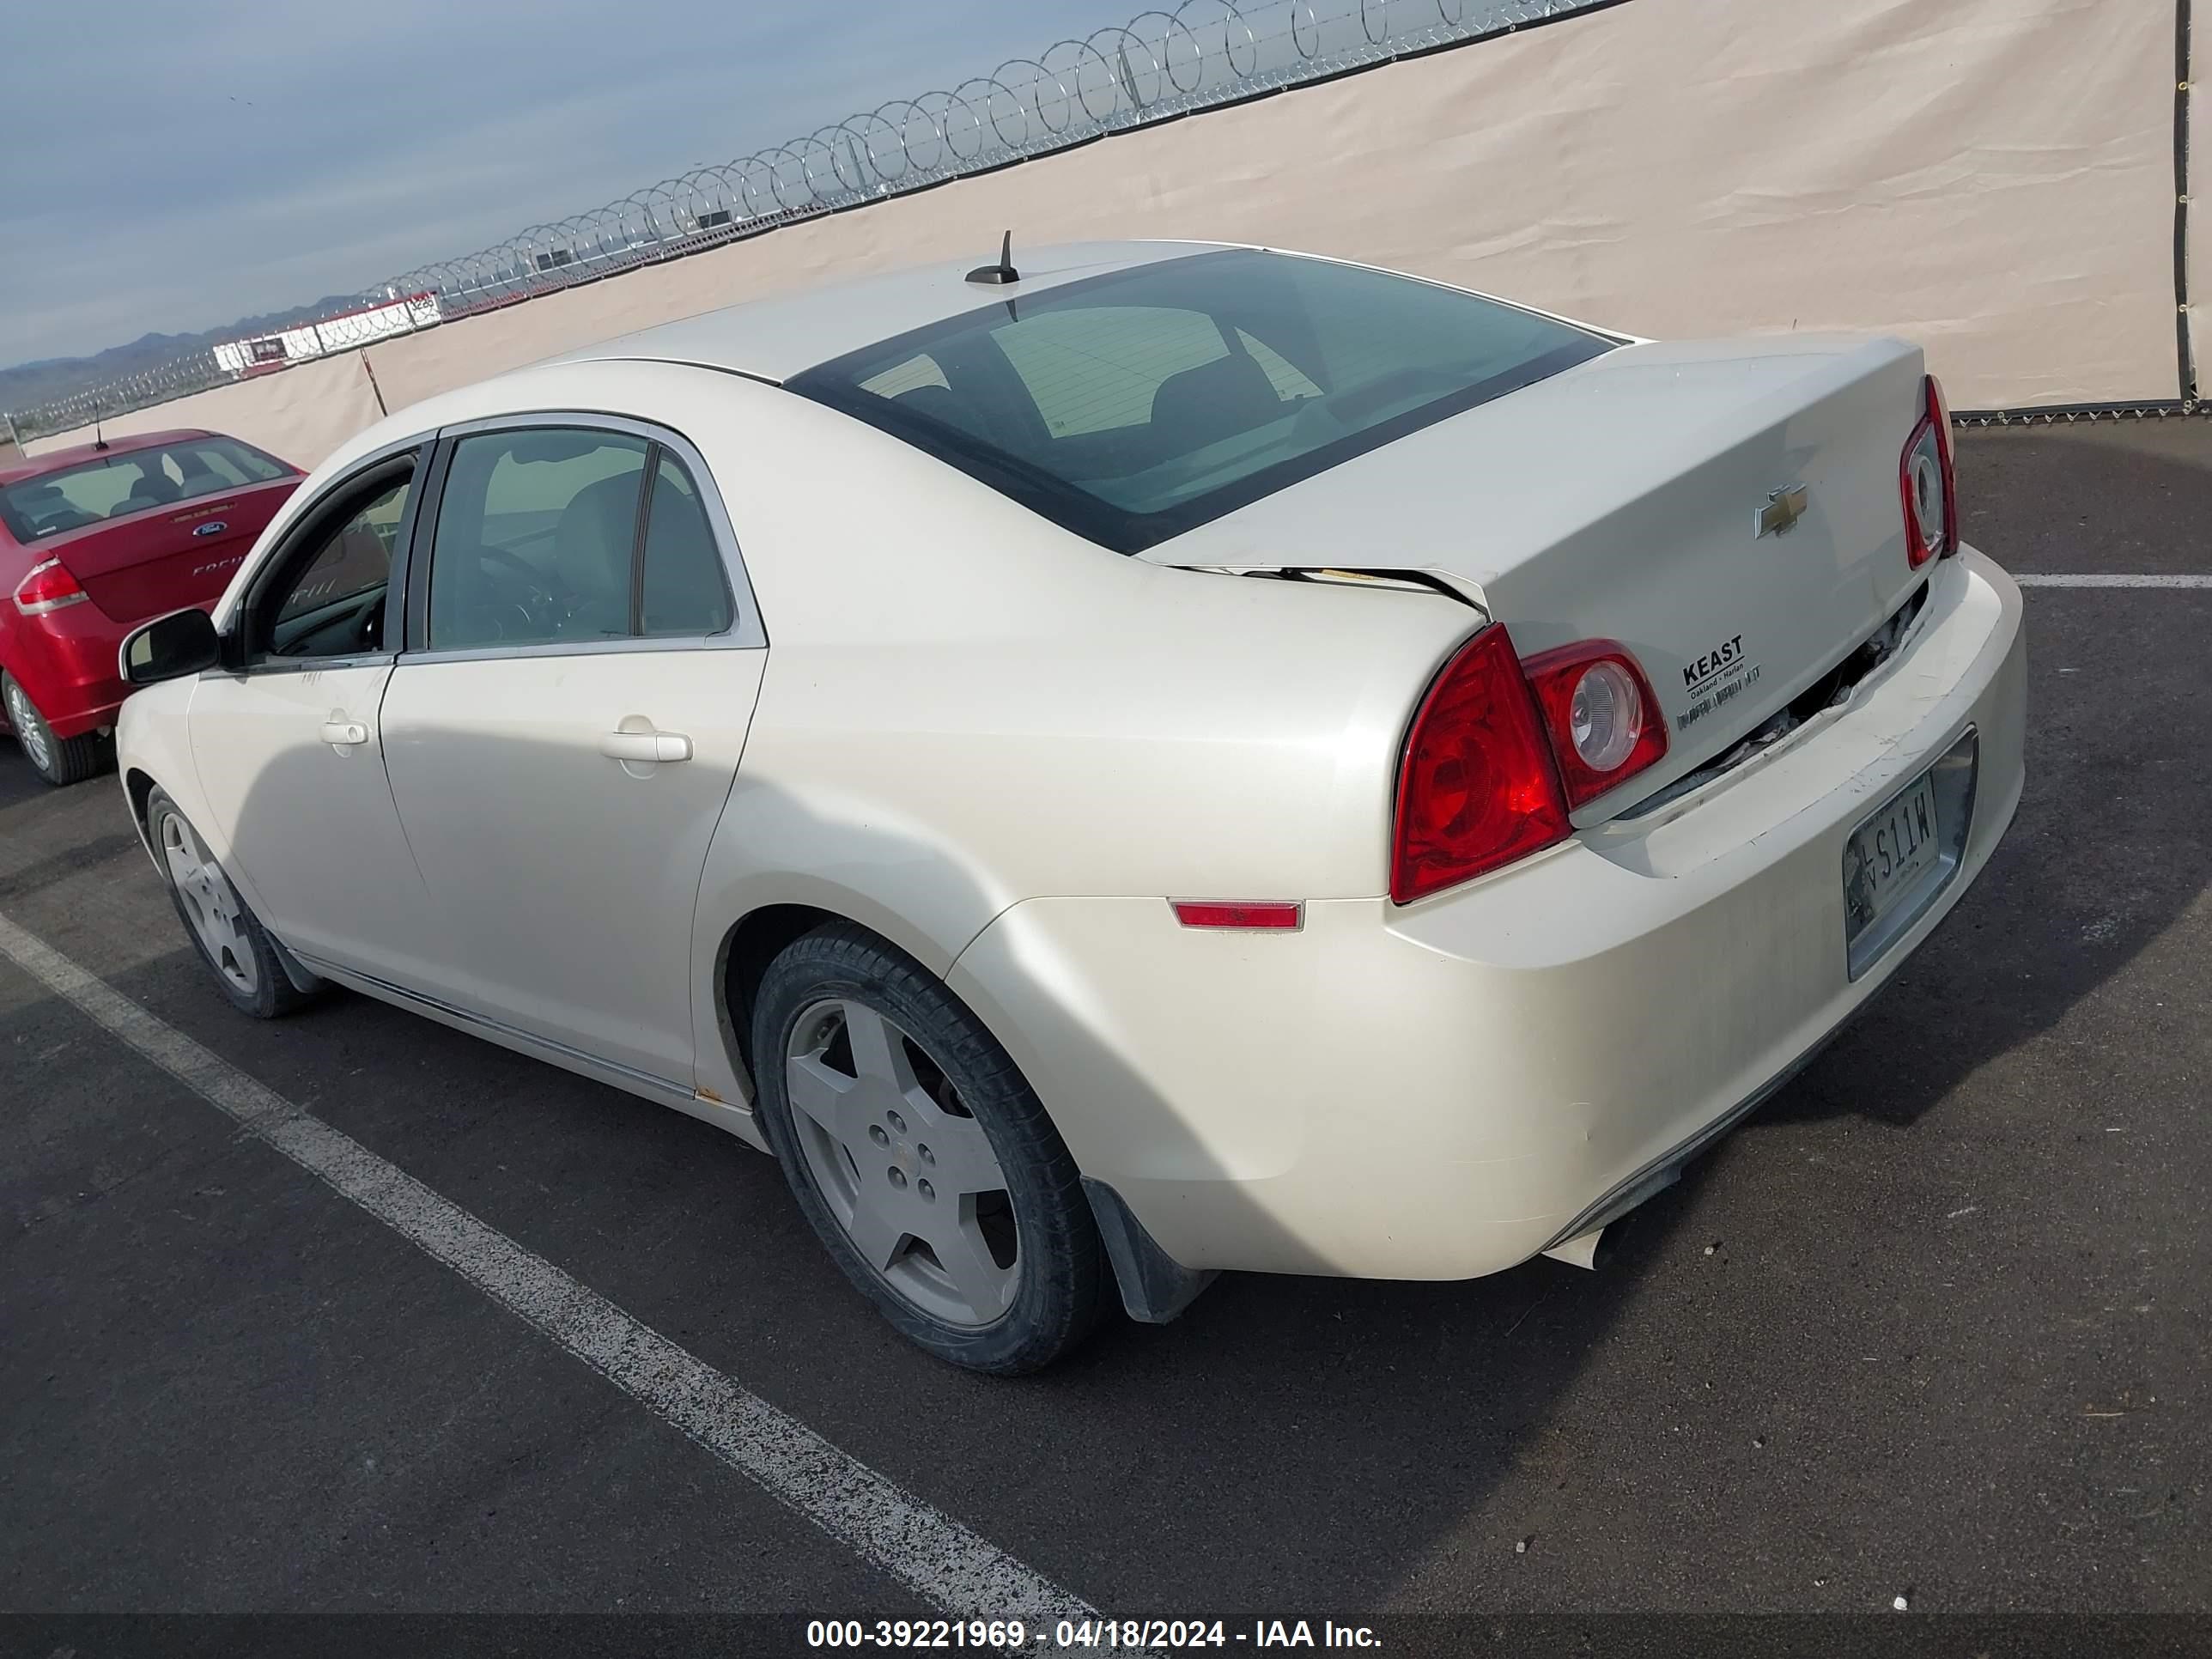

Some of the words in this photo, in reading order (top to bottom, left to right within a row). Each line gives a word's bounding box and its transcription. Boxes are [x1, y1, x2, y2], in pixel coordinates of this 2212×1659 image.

[1683, 635, 1742, 686] KEAST
[1690, 678, 1717, 700] Oakland
[1723, 663, 1744, 680] Harlan
